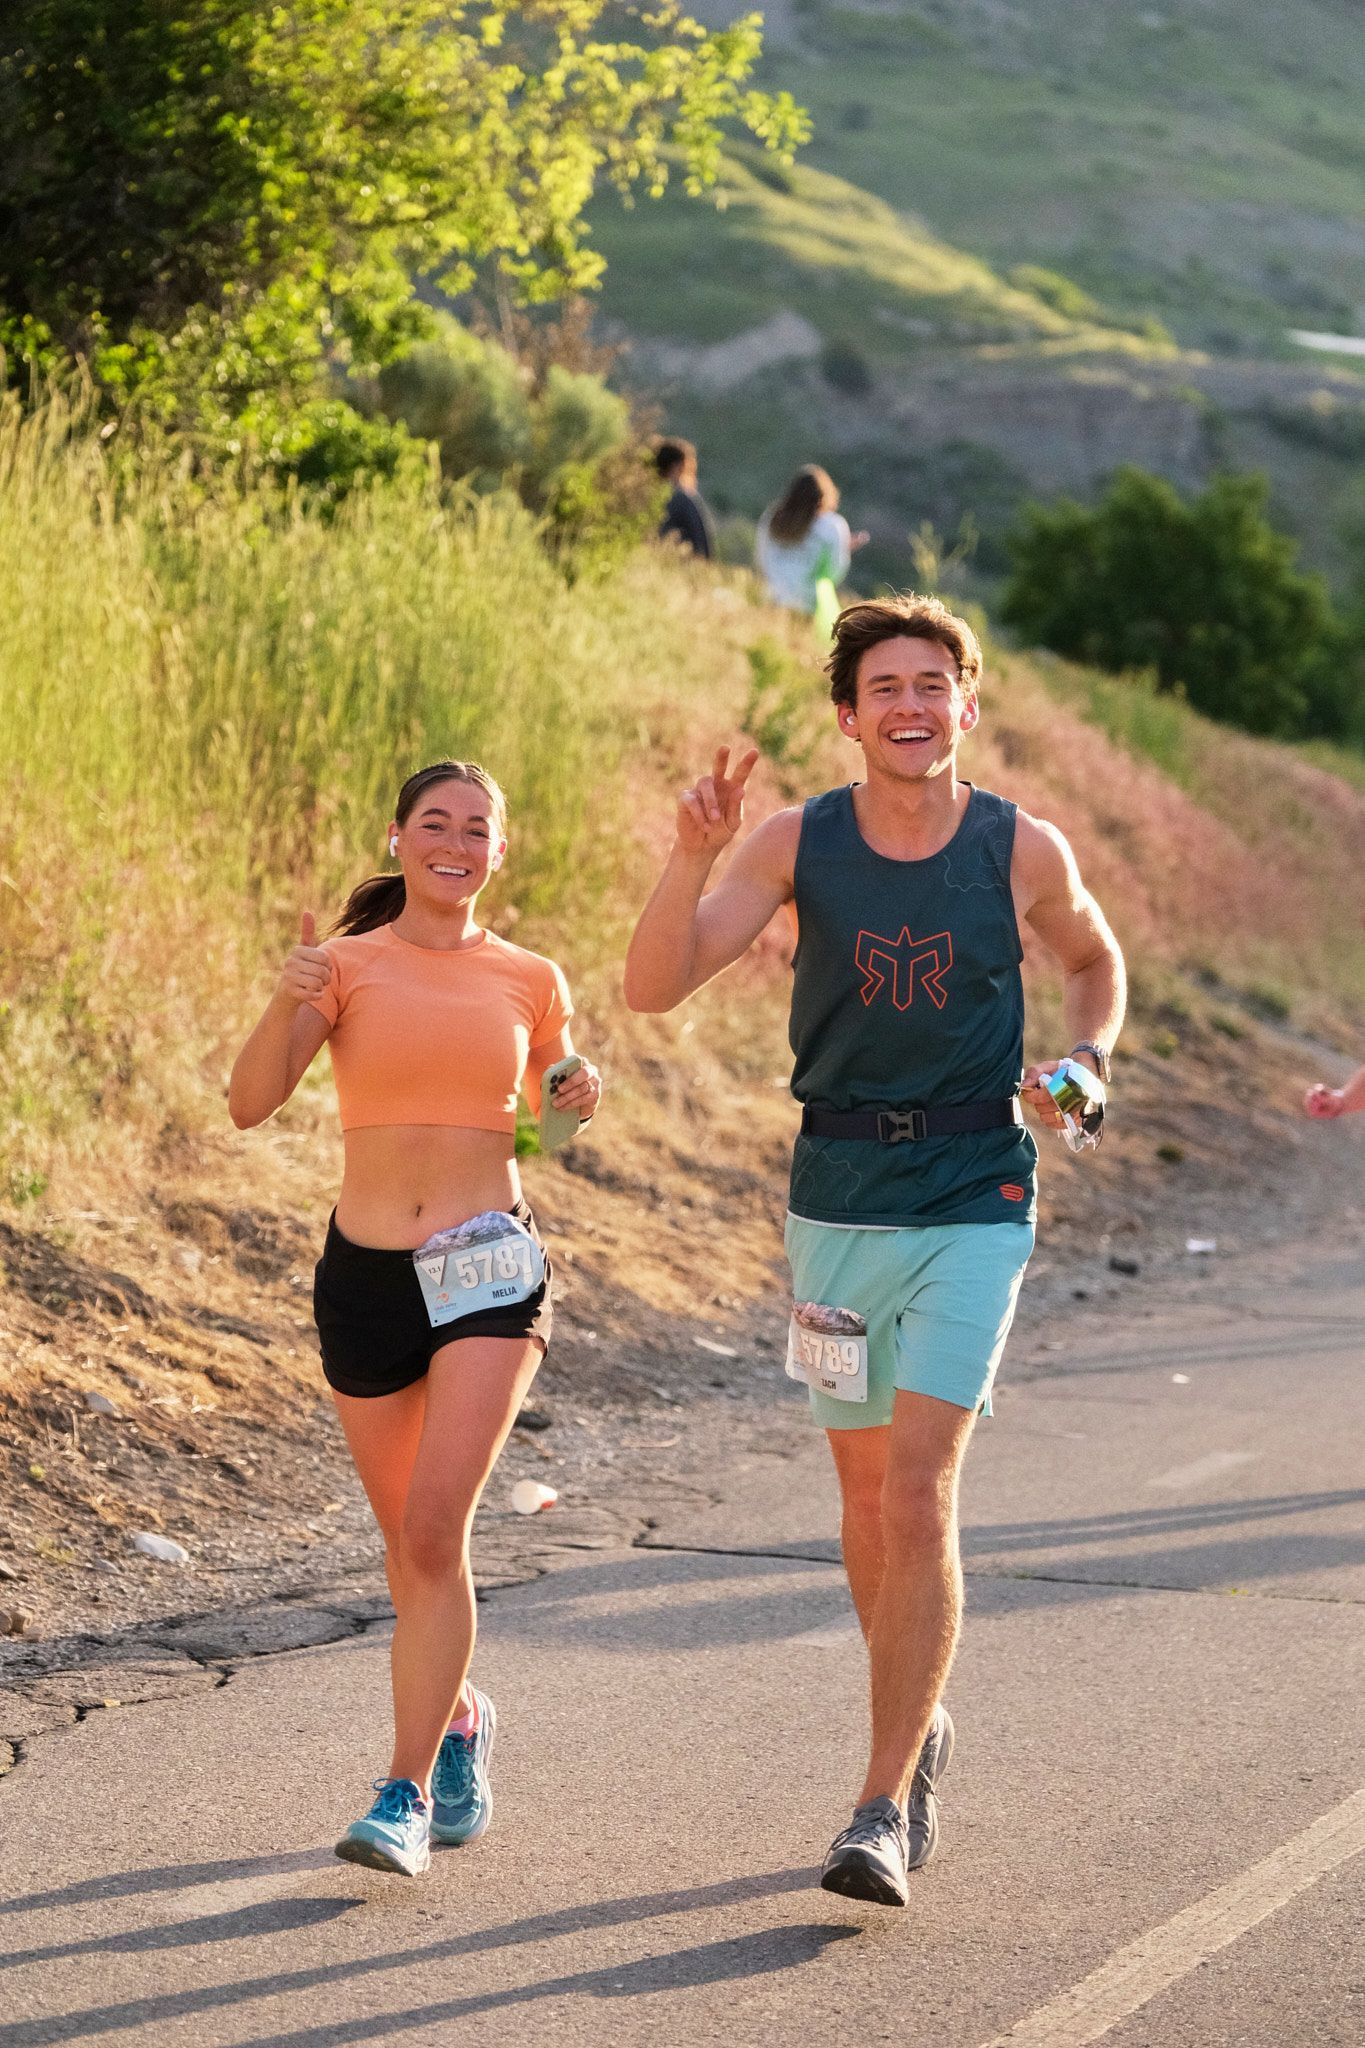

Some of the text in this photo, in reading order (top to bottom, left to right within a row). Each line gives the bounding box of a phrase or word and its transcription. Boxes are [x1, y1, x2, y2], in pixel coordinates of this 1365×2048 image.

[428, 1265, 442, 1274] 13.1
[454, 1240, 534, 1289] 5787
[492, 1286, 518, 1299] MELIA
[800, 1333, 860, 1376] 5789
